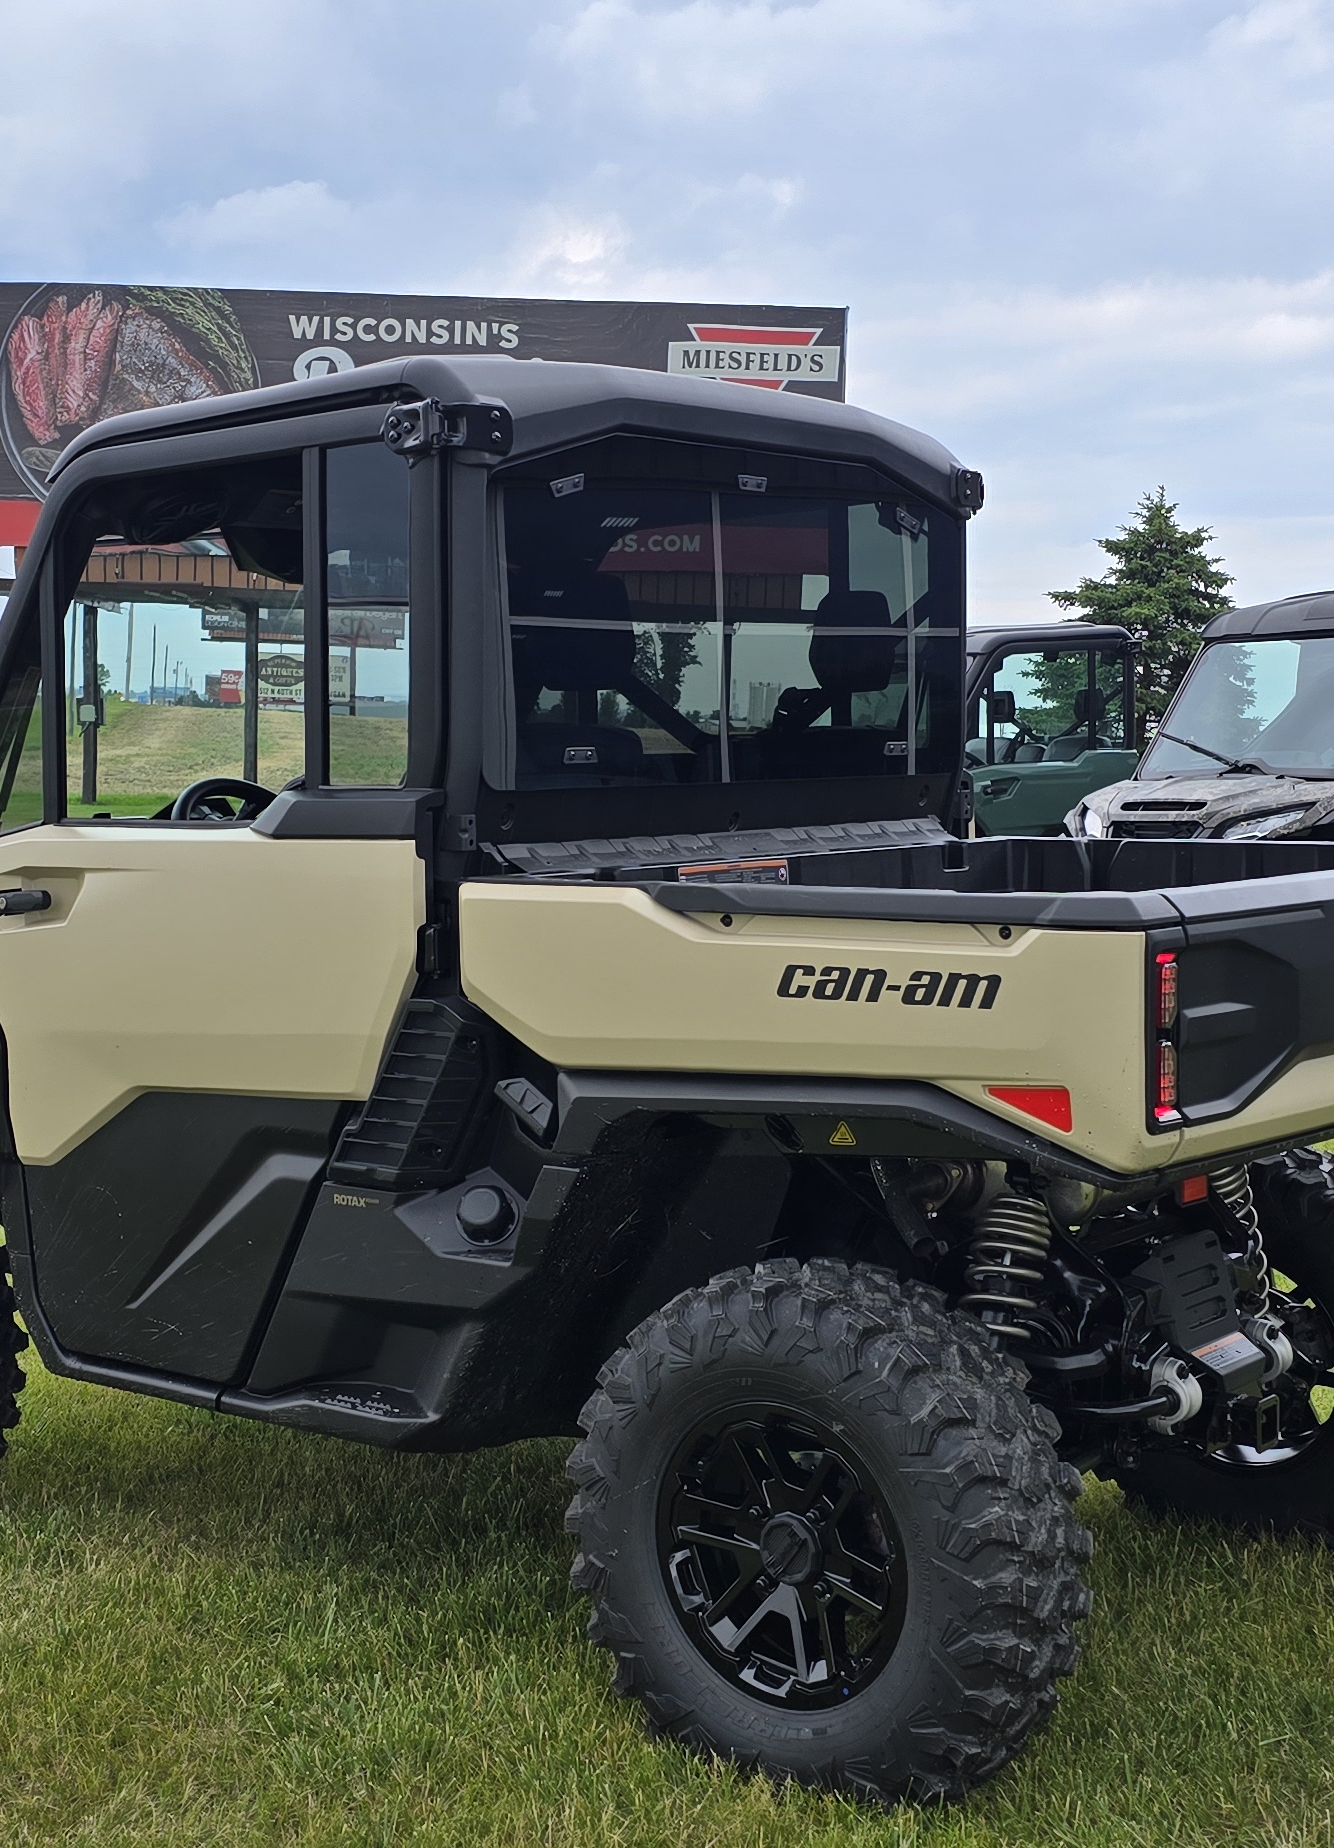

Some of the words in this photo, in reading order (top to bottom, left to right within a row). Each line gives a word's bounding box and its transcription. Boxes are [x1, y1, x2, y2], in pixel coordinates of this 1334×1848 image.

[288, 314, 520, 349] WISCONSIN'S
[681, 349, 824, 373] MIESFELD'S
[776, 964, 1002, 1010] can-am
[333, 1193, 367, 1208] ROTAX
